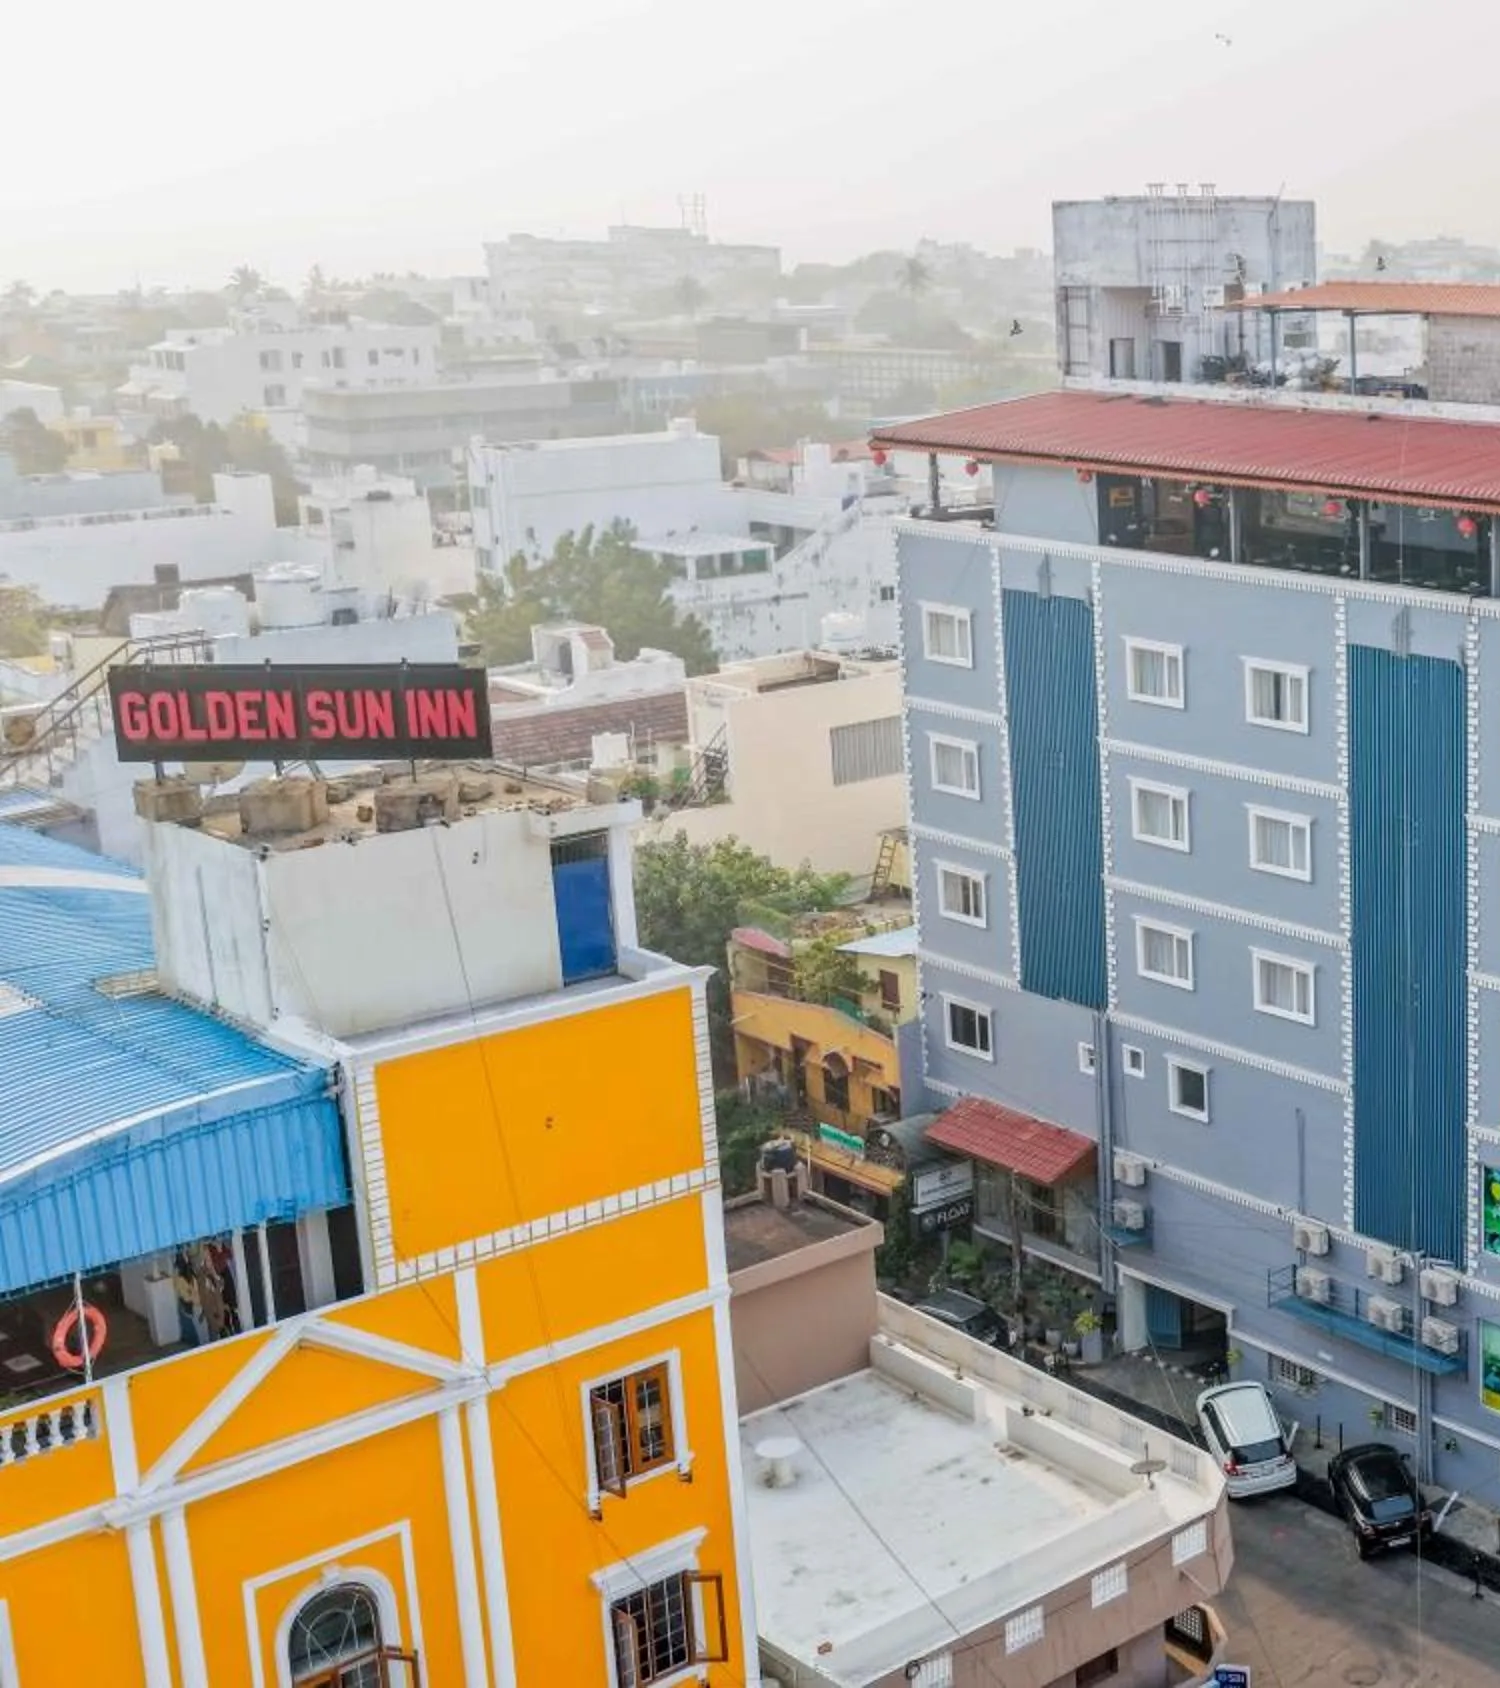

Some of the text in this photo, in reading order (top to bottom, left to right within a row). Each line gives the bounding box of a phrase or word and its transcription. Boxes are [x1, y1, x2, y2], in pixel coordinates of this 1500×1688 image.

[118, 689, 478, 741] GOLDEN SUN INN
